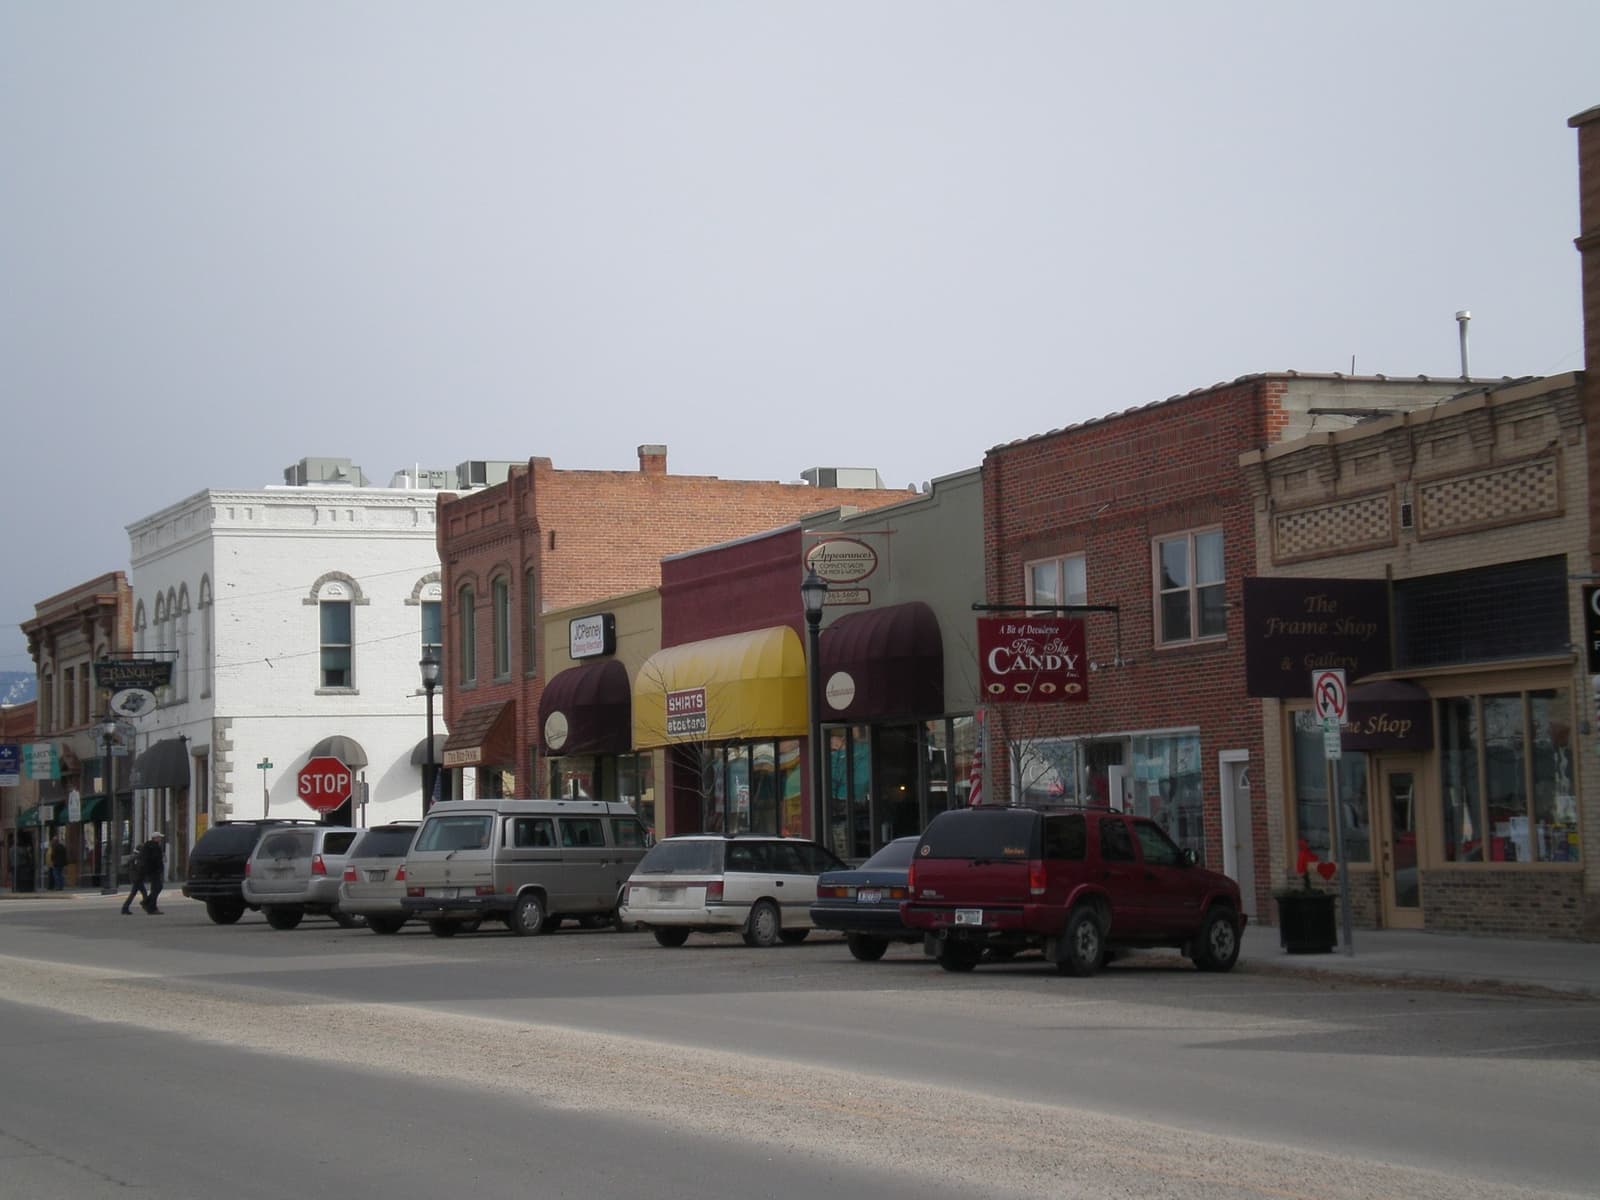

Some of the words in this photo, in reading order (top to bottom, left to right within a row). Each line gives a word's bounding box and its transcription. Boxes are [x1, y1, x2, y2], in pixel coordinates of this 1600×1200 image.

[1304, 594, 1337, 613] The
[999, 625, 1005, 635] A
[1007, 624, 1017, 635] Bit
[1018, 625, 1026, 637] of
[1264, 617, 1329, 639] Frame
[1334, 616, 1378, 641] Shop
[1010, 638, 1036, 657] Big
[1043, 638, 1069, 657] Sky
[988, 647, 1078, 675] CANDY
[1280, 655, 1294, 671] &
[1304, 651, 1359, 672] Gallery
[668, 693, 704, 712] SHIRTS
[1363, 713, 1412, 739] Shop
[300, 773, 348, 795] STOP
